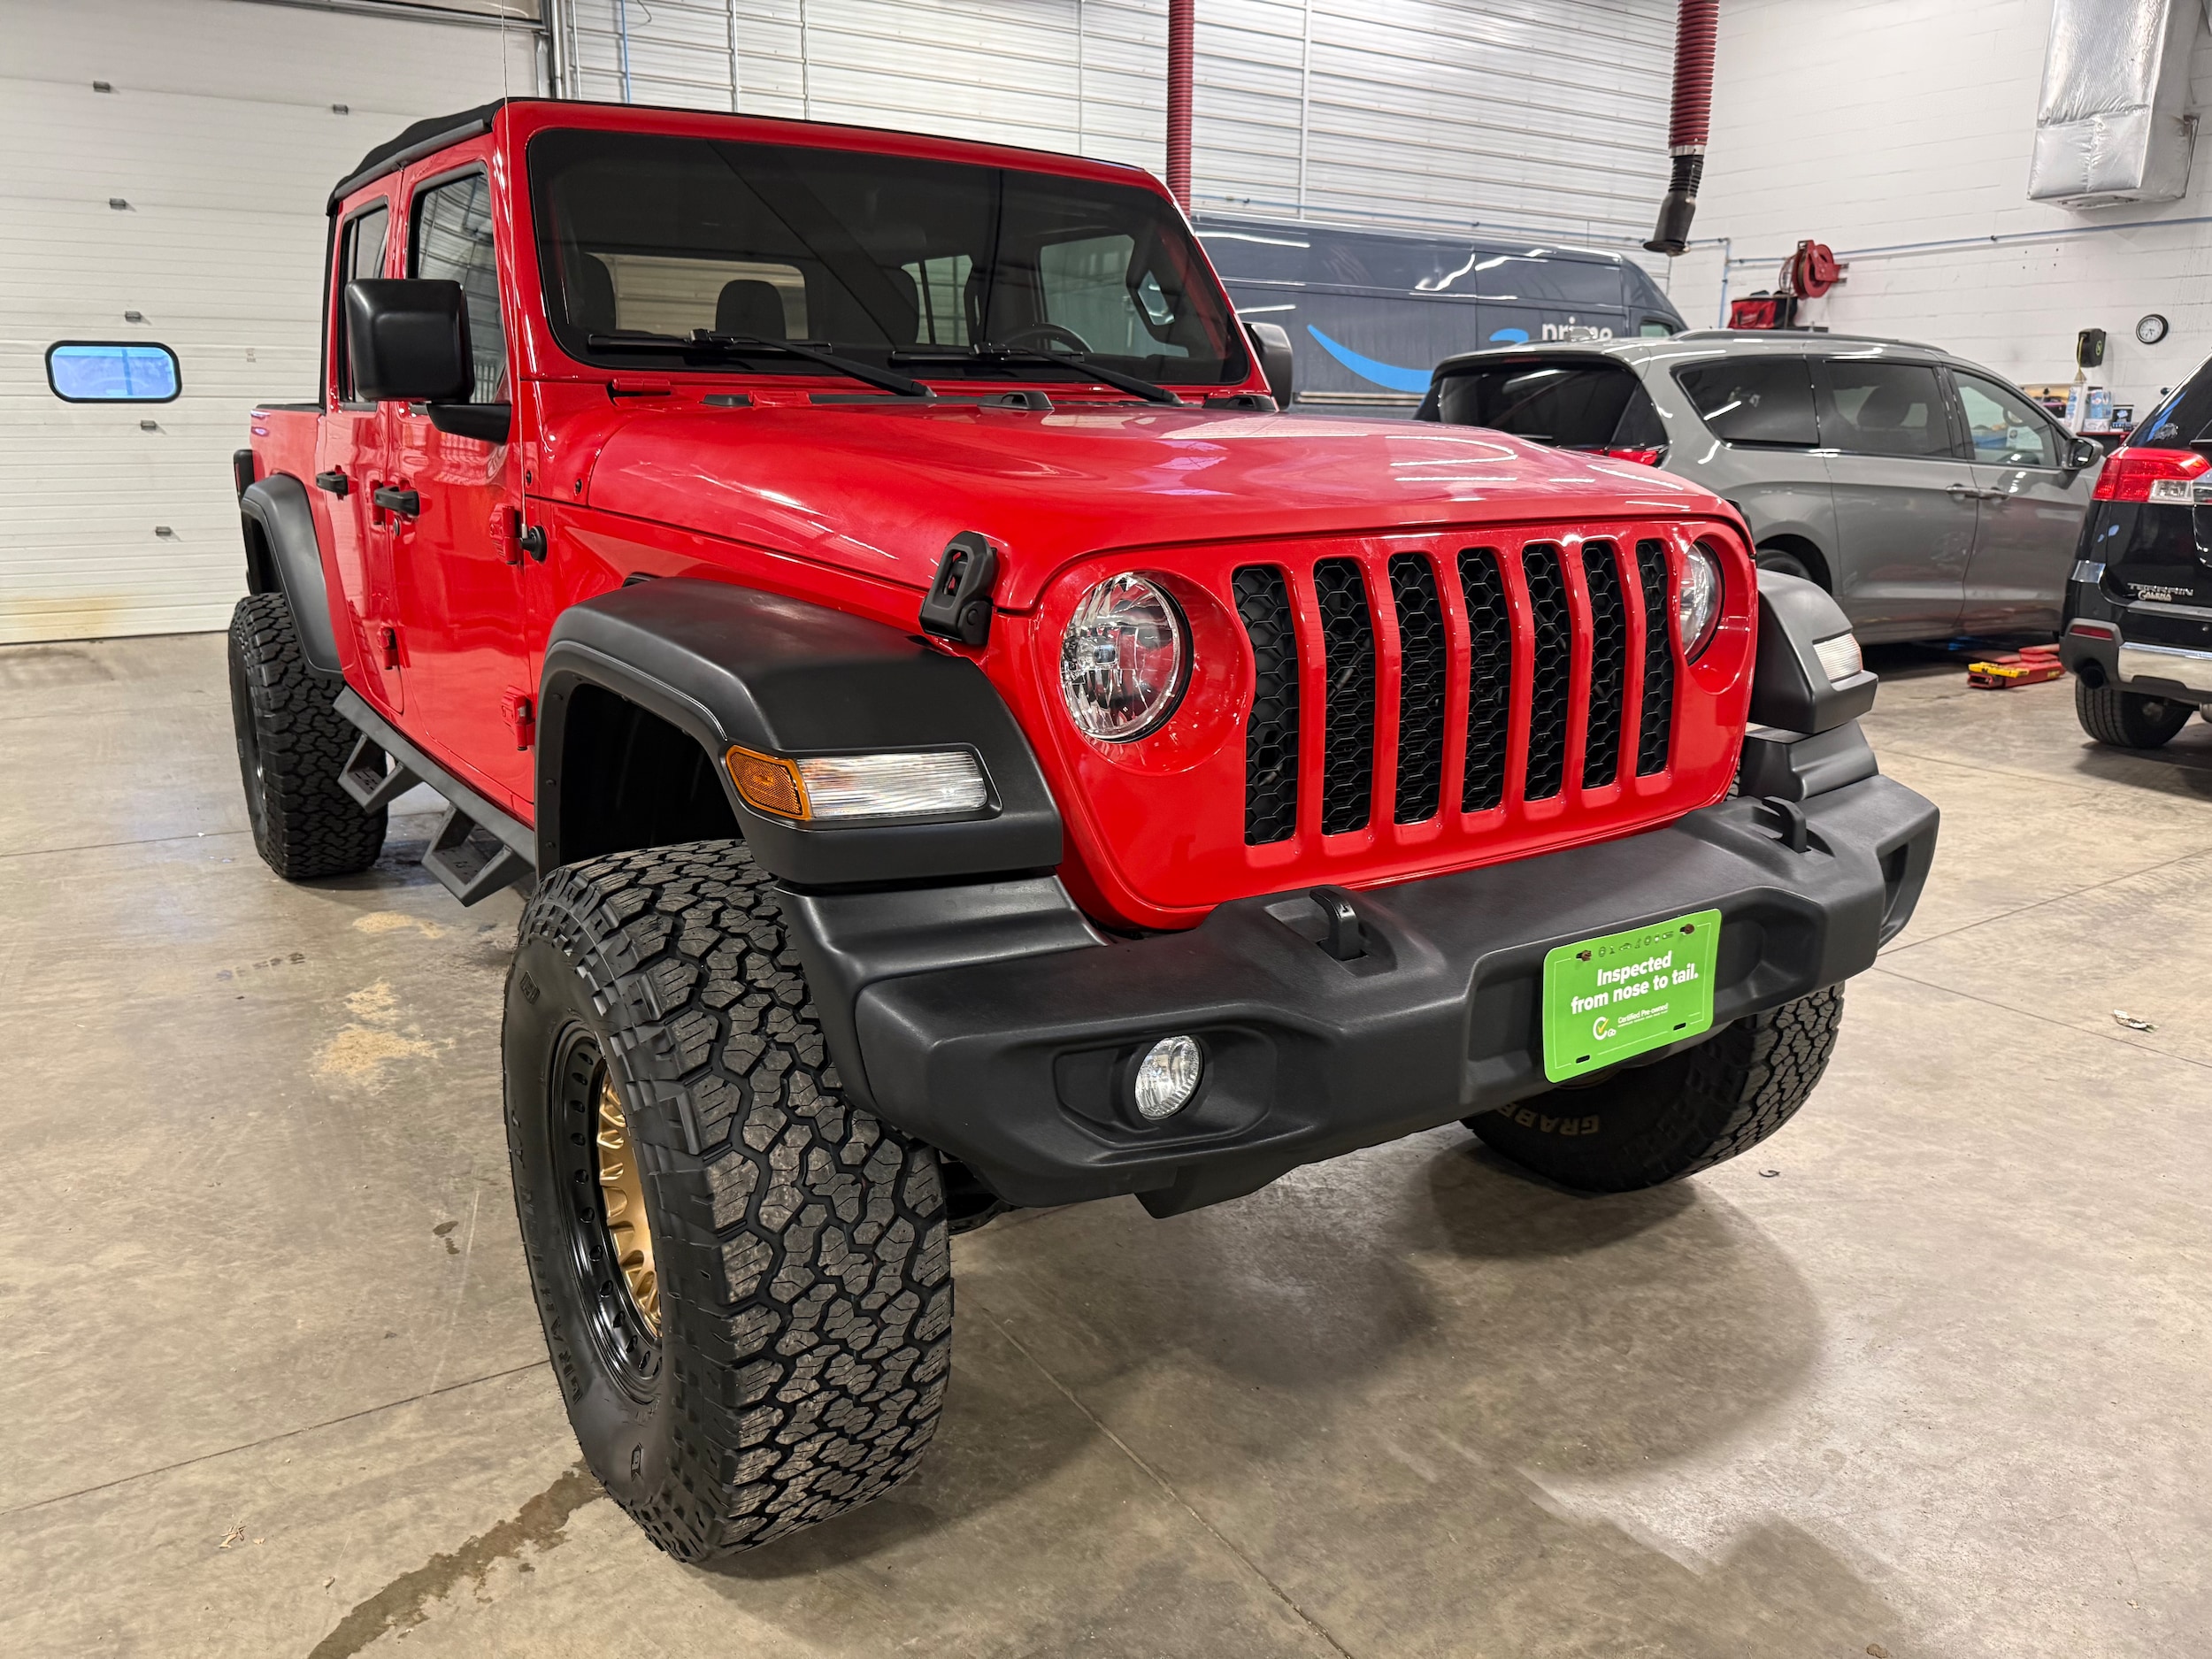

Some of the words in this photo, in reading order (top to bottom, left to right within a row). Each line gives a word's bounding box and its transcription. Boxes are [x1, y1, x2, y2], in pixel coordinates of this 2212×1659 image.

[2127, 582, 2194, 596] TERRAIN
[1597, 950, 1672, 987] Inspected
[1571, 992, 1609, 1014] from
[1613, 980, 1649, 1003] nose
[1653, 972, 1669, 991] to
[1672, 963, 1699, 985] tail.
[1617, 1011, 1641, 1025] Certified
